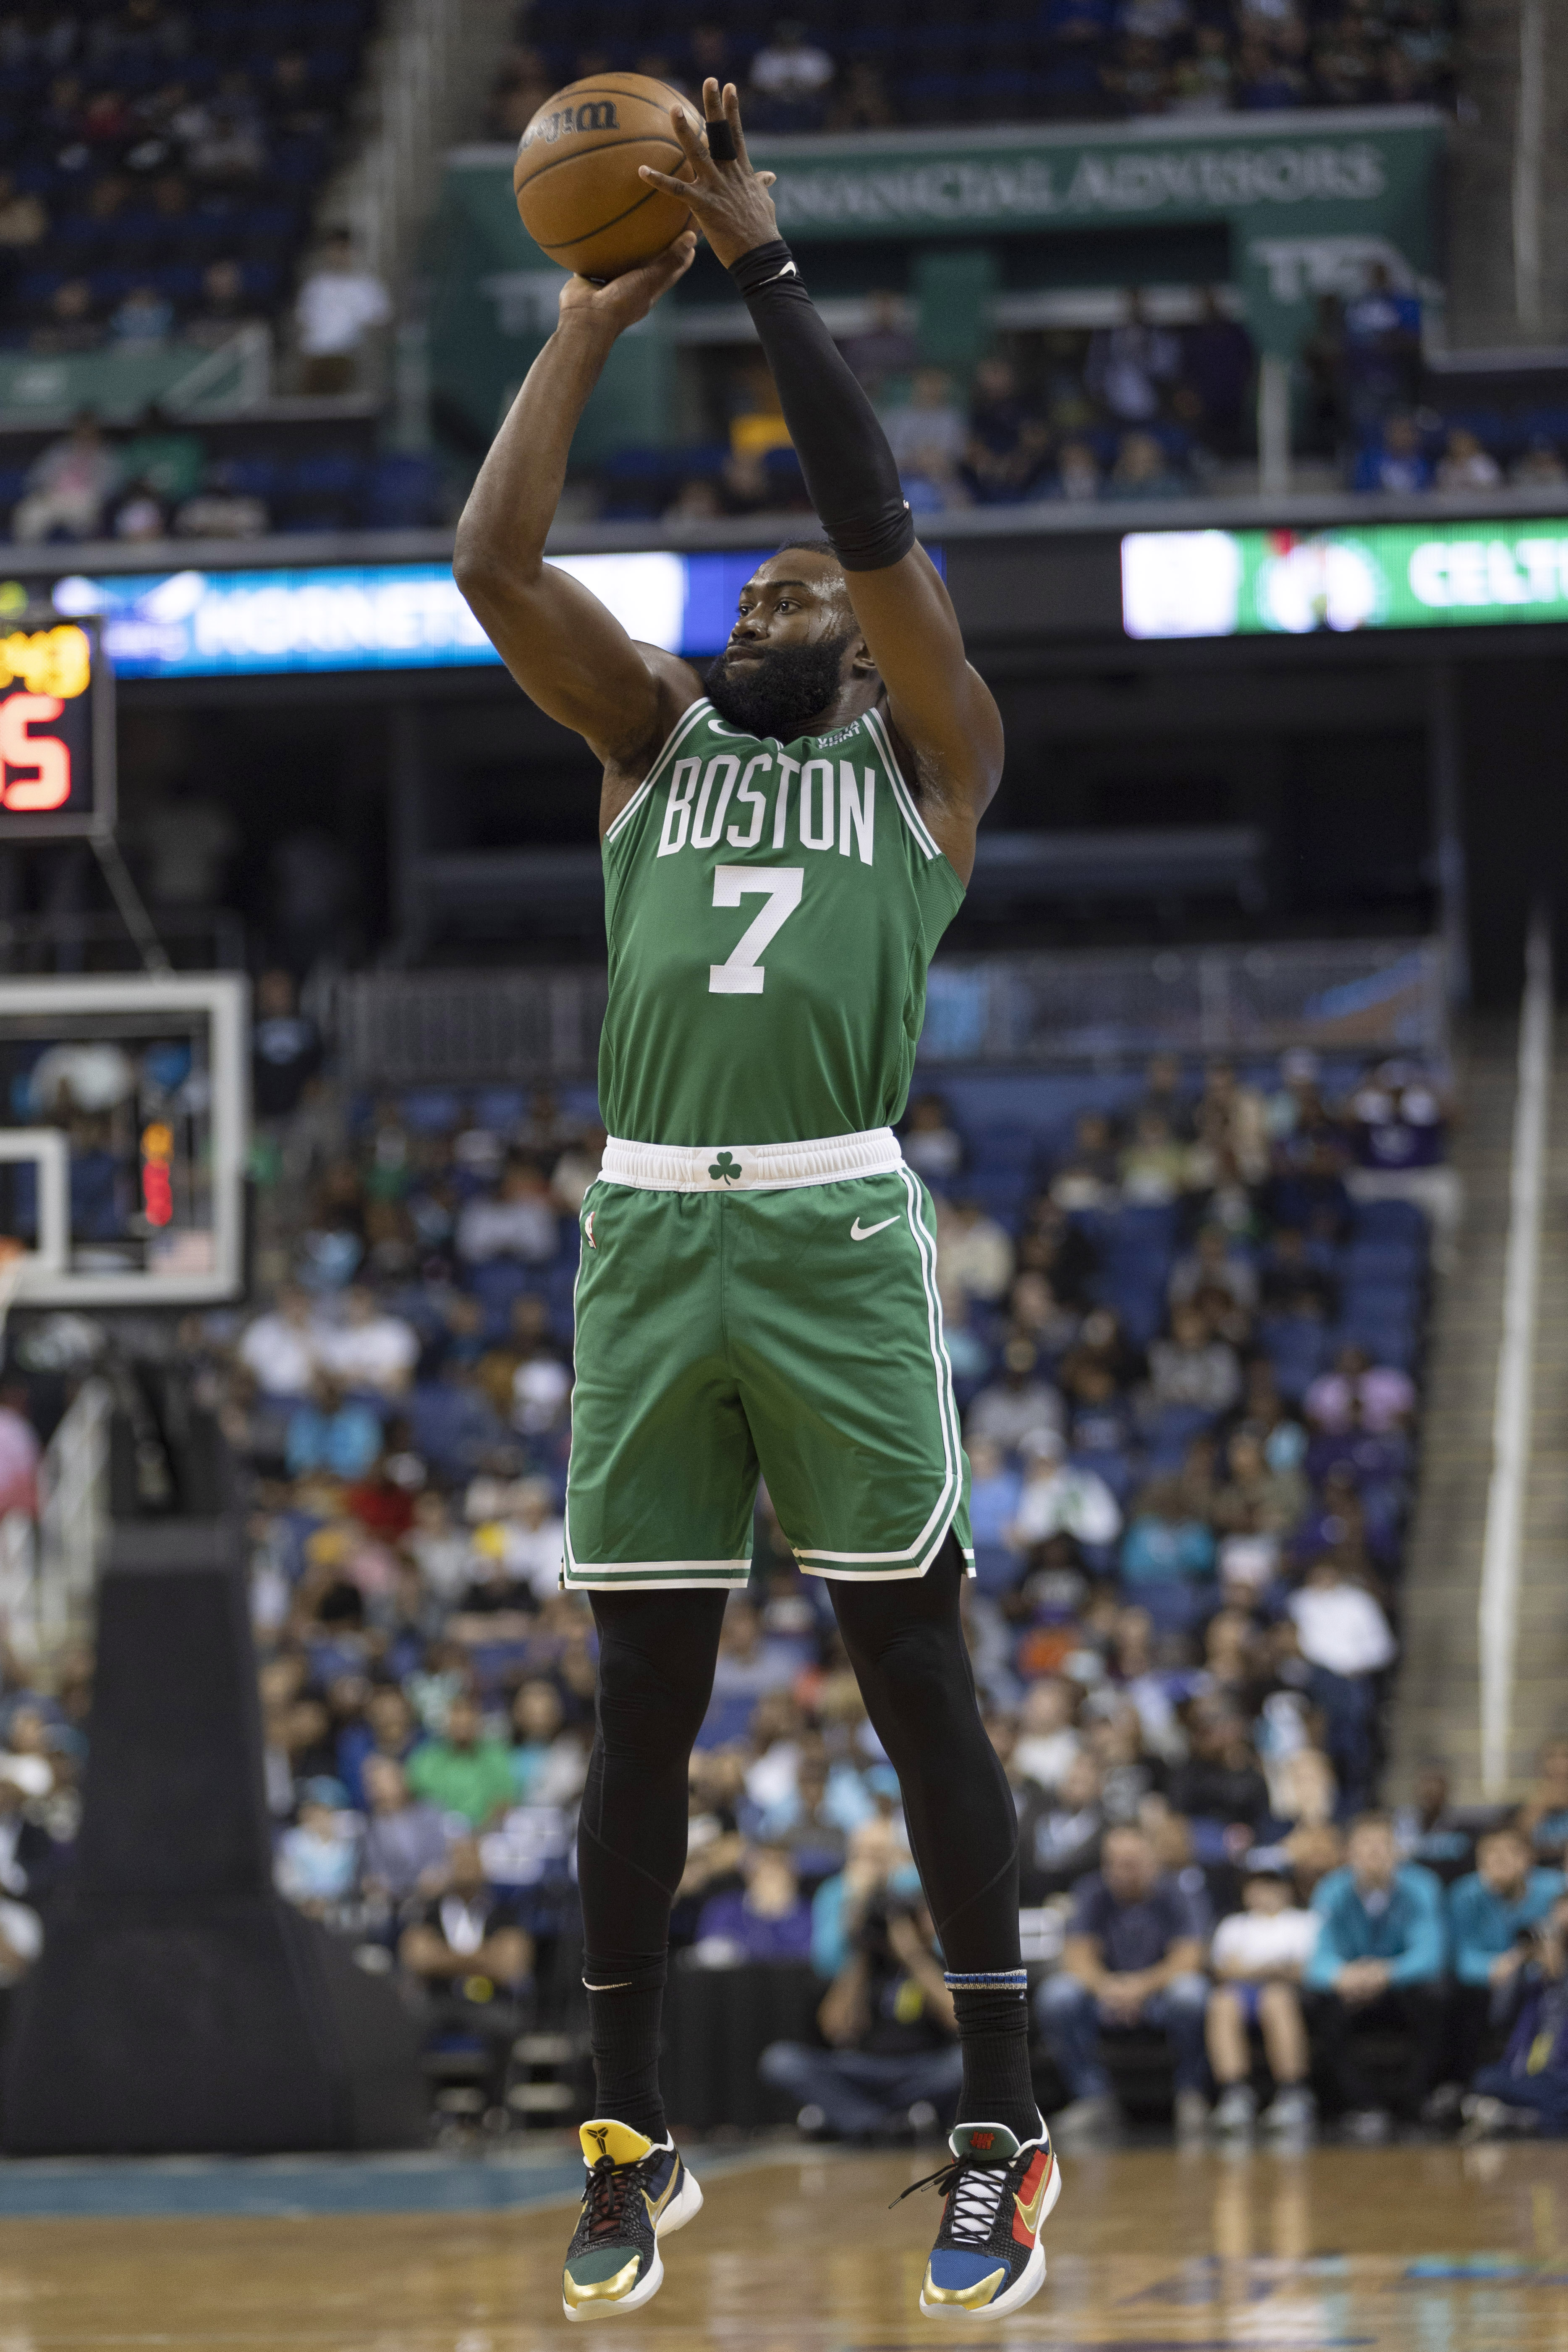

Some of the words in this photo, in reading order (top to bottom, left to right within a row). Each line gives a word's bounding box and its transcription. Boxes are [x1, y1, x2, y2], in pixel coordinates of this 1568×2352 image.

[777, 158, 1055, 226] NANCIAL
[818, 725, 860, 750] PRINT
[656, 752, 875, 866] BOSTON
[708, 865, 804, 994] 7
